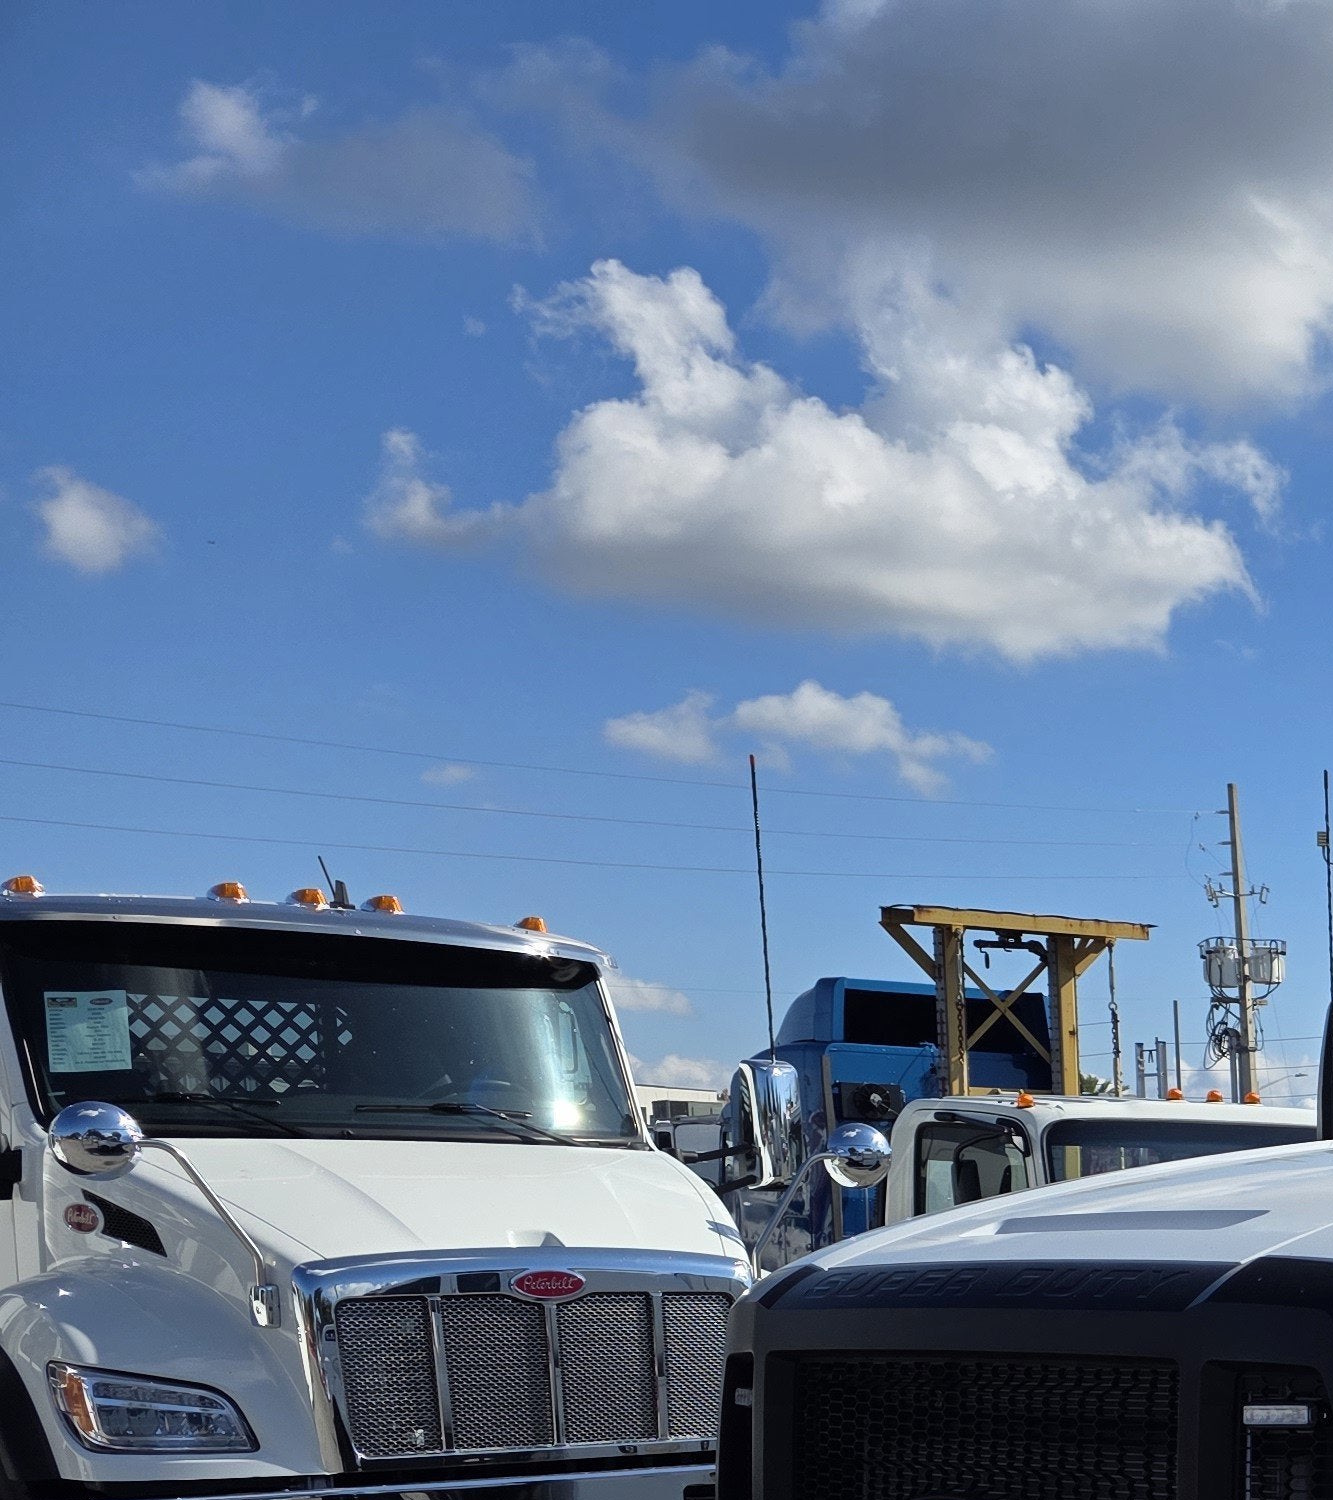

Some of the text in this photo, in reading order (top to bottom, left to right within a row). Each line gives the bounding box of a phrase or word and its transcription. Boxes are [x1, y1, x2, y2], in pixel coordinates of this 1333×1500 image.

[523, 1275, 578, 1291] Peterbilt
[806, 1268, 1190, 1299] SUPER DUTY
